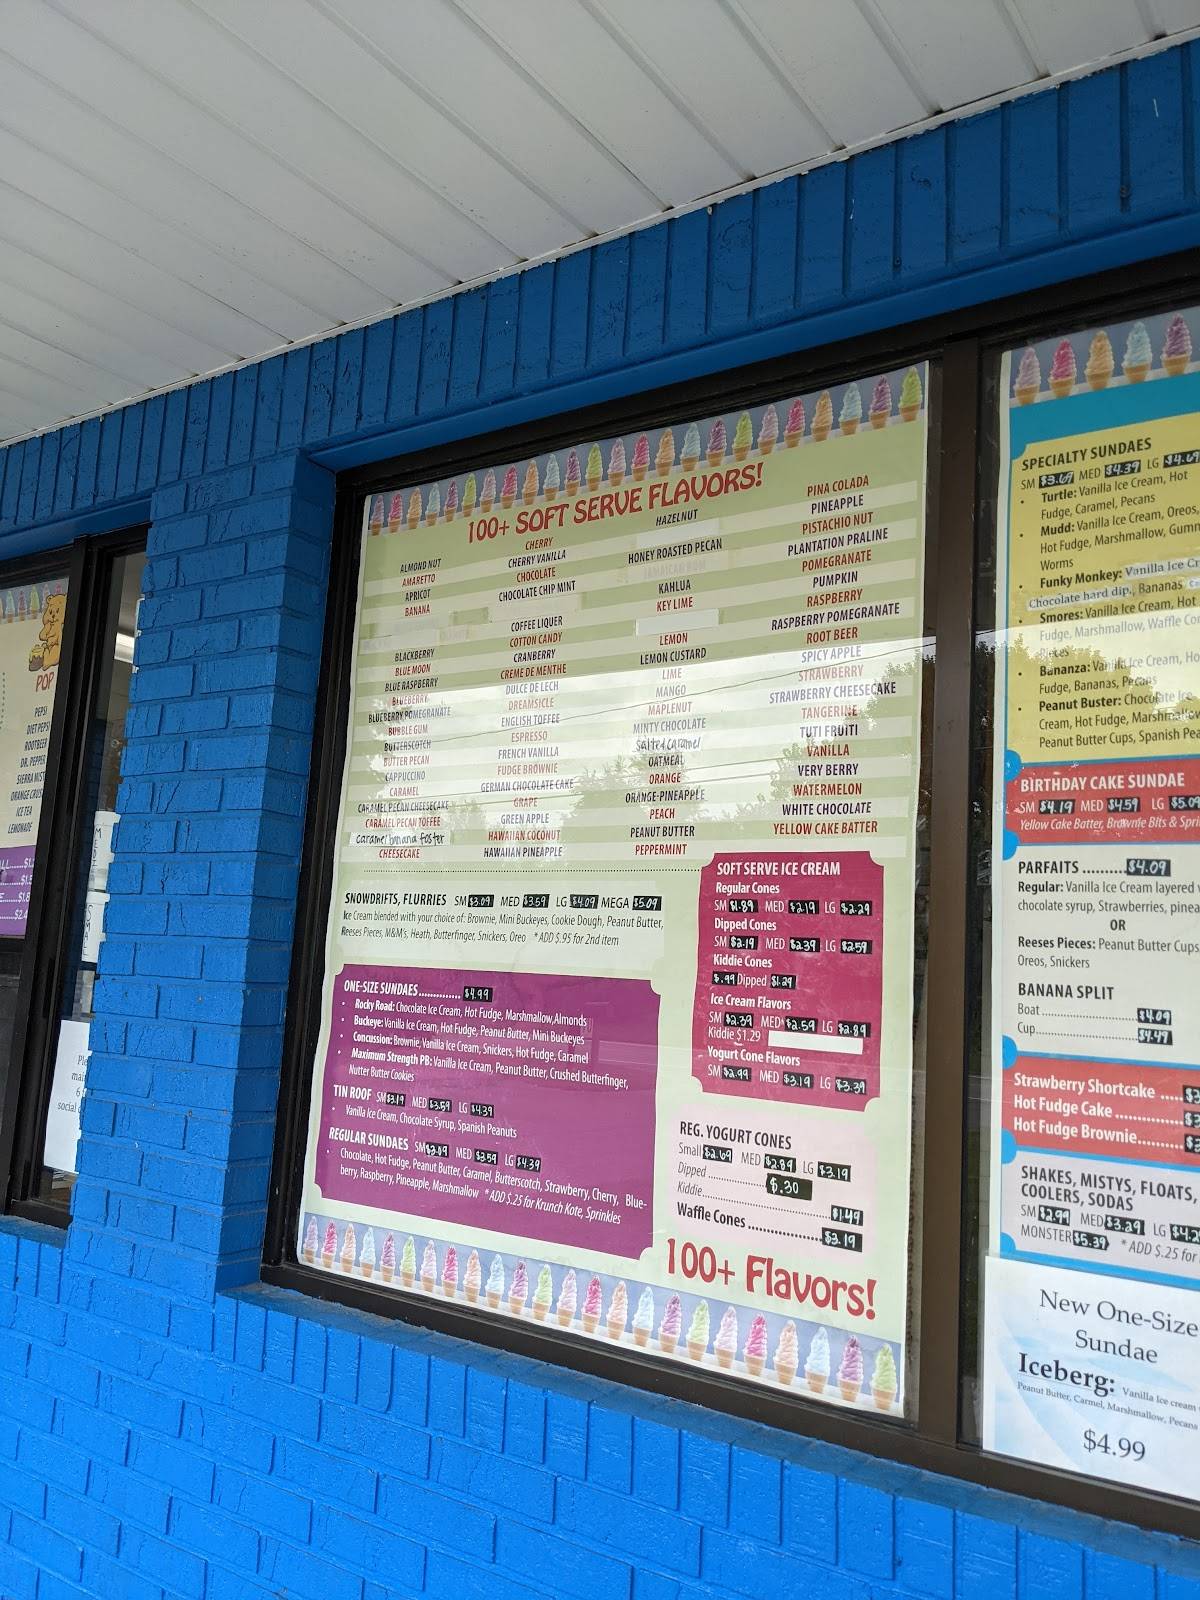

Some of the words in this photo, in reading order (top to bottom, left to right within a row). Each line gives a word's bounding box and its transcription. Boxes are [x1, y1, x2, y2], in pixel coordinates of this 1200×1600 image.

[1022, 451, 1087, 471] SPECIALTY
[1091, 438, 1152, 459] SUNDAES
[1021, 478, 1036, 489] SM
[1040, 472, 1073, 486] $3.69
[1079, 468, 1100, 480] MED
[1105, 461, 1140, 475] $4.39
[1147, 459, 1159, 469] LG
[807, 483, 829, 497] PINA
[832, 475, 869, 492] COLADA
[1042, 489, 1077, 503] Turtle:
[1079, 484, 1112, 497] Vanilla
[1114, 479, 1129, 490] Ice
[1131, 475, 1166, 488] Cream,
[1169, 471, 1188, 481] Hot
[468, 518, 509, 543] 100+
[515, 504, 570, 534] SOFT
[574, 487, 642, 523] SERVE
[648, 462, 763, 509] FLAVORS!
[1041, 508, 1072, 521] Fudge,
[1076, 499, 1118, 514] Caramel,
[1121, 494, 1155, 507] Pecans
[656, 509, 698, 526] HAZELNUT
[525, 538, 553, 550] CHERRY
[628, 549, 655, 564] HONEY
[657, 543, 693, 560] ROASTED
[695, 538, 722, 554] PECAN
[788, 536, 844, 556] PLANTATION
[847, 528, 888, 545] PRALINE
[802, 550, 871, 572] POMEGRANATE
[658, 579, 691, 594] KAHLUA
[813, 571, 858, 588] PUMPKIN
[405, 589, 430, 601] APRICOT
[499, 586, 538, 602] CHOCOLATE
[539, 583, 554, 598] CHIP
[556, 581, 575, 594] MINT
[807, 589, 862, 607] RASPBERRY
[657, 600, 671, 612] KEY
[673, 597, 693, 610] LIME
[513, 649, 555, 663] CRANBERRY
[36, 672, 54, 692] POP
[793, 783, 862, 796] WATERMELON
[1021, 777, 1086, 792] BIRTHDAY
[1090, 775, 1124, 789] CAKE
[1128, 773, 1184, 788] SUNDAE
[23, 808, 32, 817] TEA
[782, 804, 814, 815] WHITE
[816, 802, 871, 815] CHOCOLATE
[8, 823, 32, 834] LEMONADE
[773, 823, 812, 835] YELLOW
[815, 822, 839, 834] CAKE
[841, 821, 877, 834] BATTER
[379, 849, 420, 859] CHEESECAKE
[636, 844, 687, 855] PEPPERMINT
[717, 863, 742, 875] SOFT
[744, 863, 778, 875] SERVE
[781, 863, 798, 875] ICE
[801, 863, 840, 875] CREAM
[1019, 861, 1079, 874] PARFAITS
[1128, 860, 1166, 875] $4.09
[716, 883, 750, 894] Regular
[752, 883, 779, 893] Cones
[345, 893, 401, 906] SNOWDRIFTS,
[403, 893, 446, 906] FLURRIES
[455, 895, 467, 906] SM
[468, 895, 493, 907] $3.09
[500, 896, 520, 907] MED
[523, 895, 547, 907] $3.59
[556, 896, 567, 907] LG
[571, 895, 595, 908] $4.09
[601, 897, 629, 909] MEGA
[633, 897, 657, 910] $5.09
[714, 900, 727, 911] SM
[730, 900, 754, 912] $1.89
[765, 901, 784, 912] MED
[790, 901, 816, 914] $2.19
[825, 902, 835, 913] LG
[840, 902, 870, 915] $2.29
[715, 918, 747, 931] Dipped
[750, 919, 776, 931] Cones
[1110, 920, 1126, 931] OR
[714, 954, 742, 966] Kiddie
[745, 956, 772, 968] Cones
[1018, 955, 1047, 968] Oreos,
[1050, 956, 1089, 968] Snickers
[344, 981, 378, 994] ONE-SIZE
[380, 983, 418, 996] SUNDAES
[464, 988, 490, 1000] $4.99
[1019, 983, 1073, 998] BANANA
[1077, 985, 1114, 1000] SPLIT
[711, 994, 723, 1005] Ice
[725, 995, 755, 1008] Cream
[758, 997, 791, 1010] Flavors
[1018, 1003, 1039, 1015] Boat
[1139, 1009, 1170, 1024] $4.09
[709, 1026, 734, 1040] Kiddie
[736, 1030, 760, 1042] $1.29
[708, 1047, 738, 1061] Yogurt
[740, 1049, 763, 1062] Cone
[766, 1051, 800, 1065] Flavors
[1014, 1073, 1085, 1095] Strawberry
[1088, 1079, 1155, 1099] Shortcake
[58, 1102, 76, 1113] social
[334, 1085, 348, 1098] TIN
[350, 1086, 371, 1100] ROOF
[376, 1091, 386, 1103] SM
[386, 1093, 404, 1105] $3.19
[412, 1096, 427, 1108] MED
[429, 1098, 450, 1111] $3.59
[458, 1102, 467, 1113] LG
[471, 1103, 493, 1117] $4.39
[1014, 1095, 1036, 1110] Hot
[1039, 1097, 1077, 1118] Fudge
[1081, 1101, 1112, 1117] Cake
[346, 1105, 365, 1117] Vanilla
[367, 1107, 375, 1118] Ice
[377, 1109, 398, 1124] Cream,
[399, 1112, 432, 1127] Chocolate
[434, 1116, 456, 1133] Syrup,
[458, 1121, 485, 1135] Spanish
[487, 1124, 517, 1138] Peanuts
[329, 1127, 365, 1145] REGULAR
[367, 1132, 408, 1151] SUNDAES
[680, 1122, 703, 1137] REG.
[706, 1125, 752, 1144] YOGURT
[755, 1132, 791, 1149] CONES
[679, 1143, 701, 1156] Small
[704, 1146, 732, 1161] $2.69
[741, 1152, 761, 1166] MED
[765, 1156, 794, 1172] $2.89
[803, 1162, 813, 1174] LG
[819, 1163, 848, 1179] $3.19
[678, 1162, 706, 1178] Dipped
[769, 1178, 799, 1193] $.30
[1022, 1166, 1077, 1187] SHAKES,
[1080, 1173, 1136, 1195] MISTYS,
[1141, 1181, 1198, 1204] FLOATS,
[677, 1182, 702, 1196] Kiddie
[832, 1208, 860, 1223] $1.49
[677, 1202, 711, 1221] Waffle
[714, 1210, 745, 1228] Cones
[825, 1230, 856, 1248] $3.19
[667, 1239, 735, 1285] 100+
[747, 1255, 876, 1320] Flavors!
[1040, 1289, 1090, 1315] New
[1097, 1301, 1198, 1337] One-Size
[1075, 1330, 1158, 1363] Sundae
[1018, 1353, 1115, 1397] Iceberg:
[1084, 1428, 1145, 1461] $4.99
